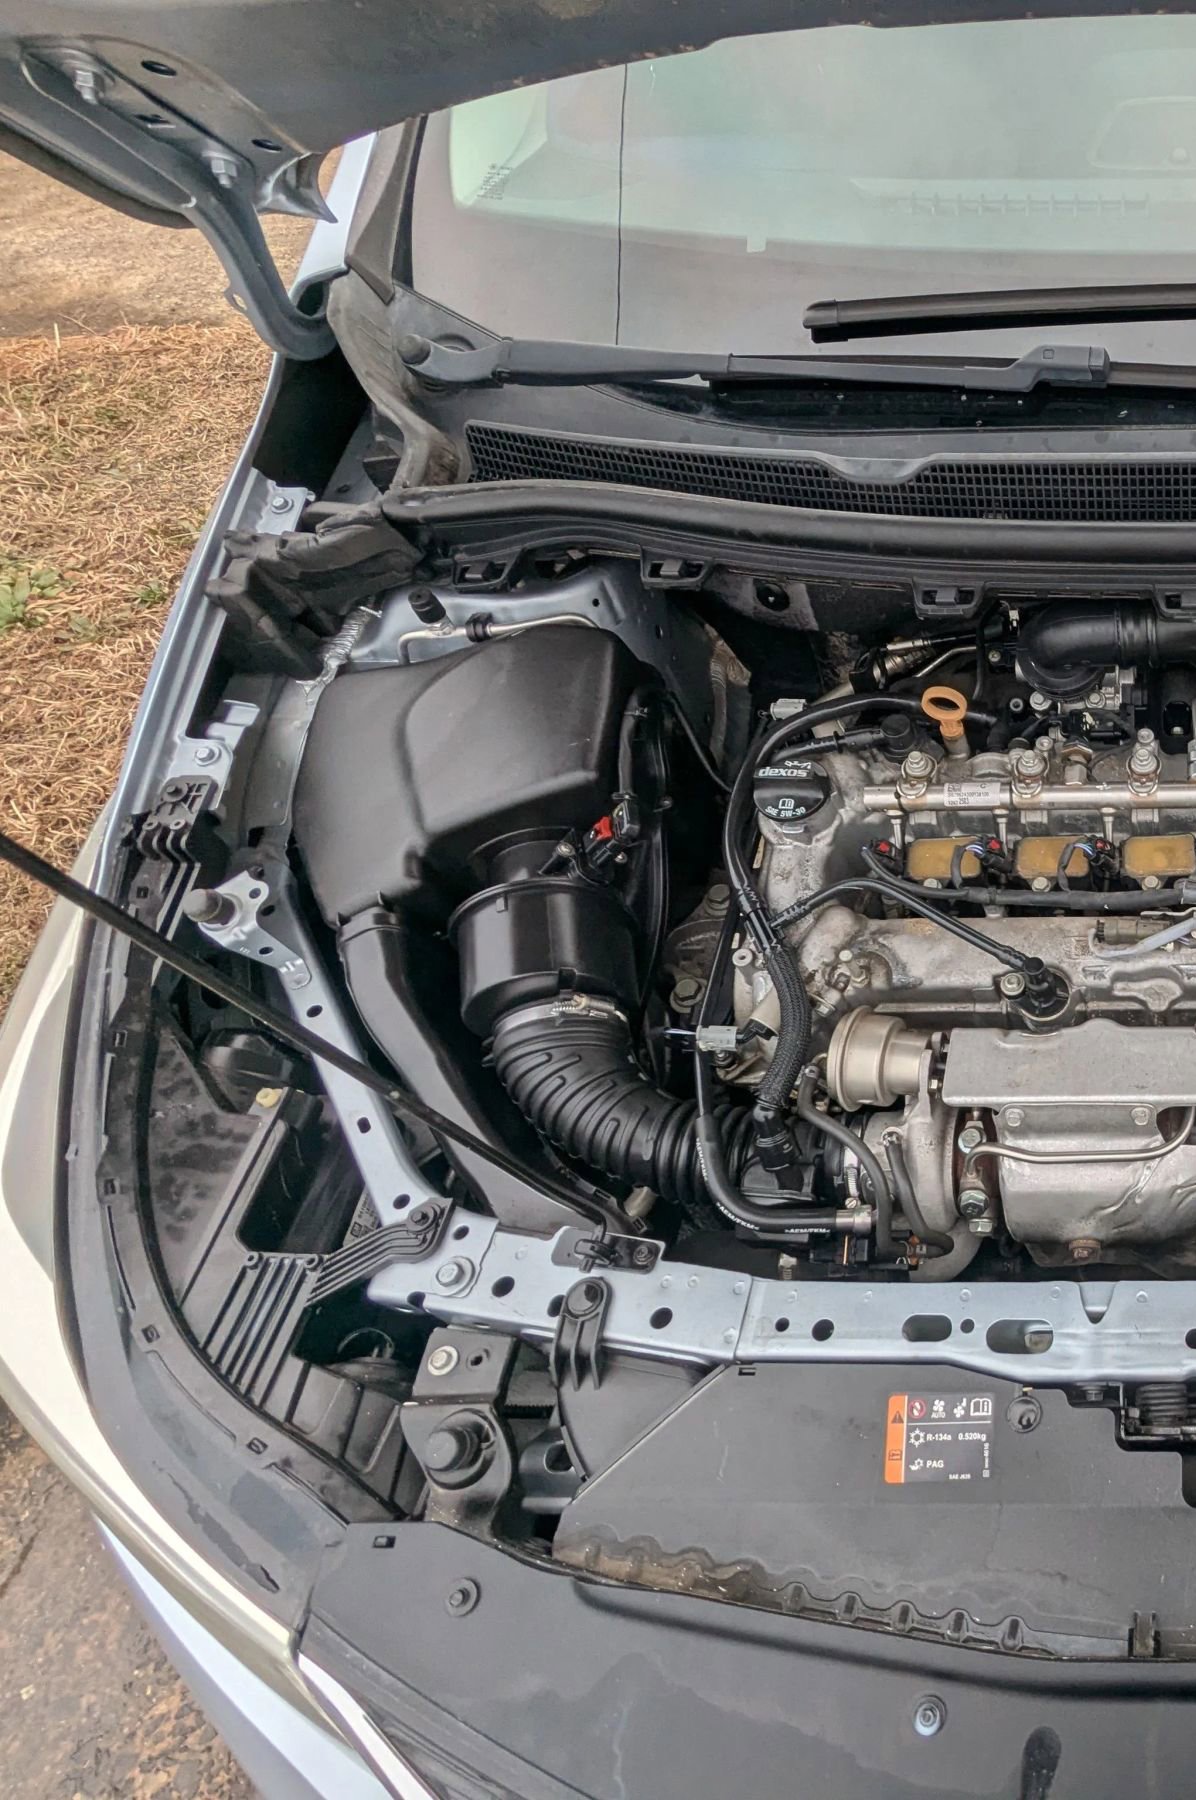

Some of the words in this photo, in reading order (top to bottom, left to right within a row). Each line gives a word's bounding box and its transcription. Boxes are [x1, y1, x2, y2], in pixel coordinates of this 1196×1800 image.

[759, 767, 809, 777] dexos
[765, 806, 779, 816] SAE
[780, 806, 806, 817] 5W-30
[926, 1433, 952, 1441] R-134a
[958, 1432, 987, 1442] 0.520kg
[926, 1460, 945, 1468] PAG
